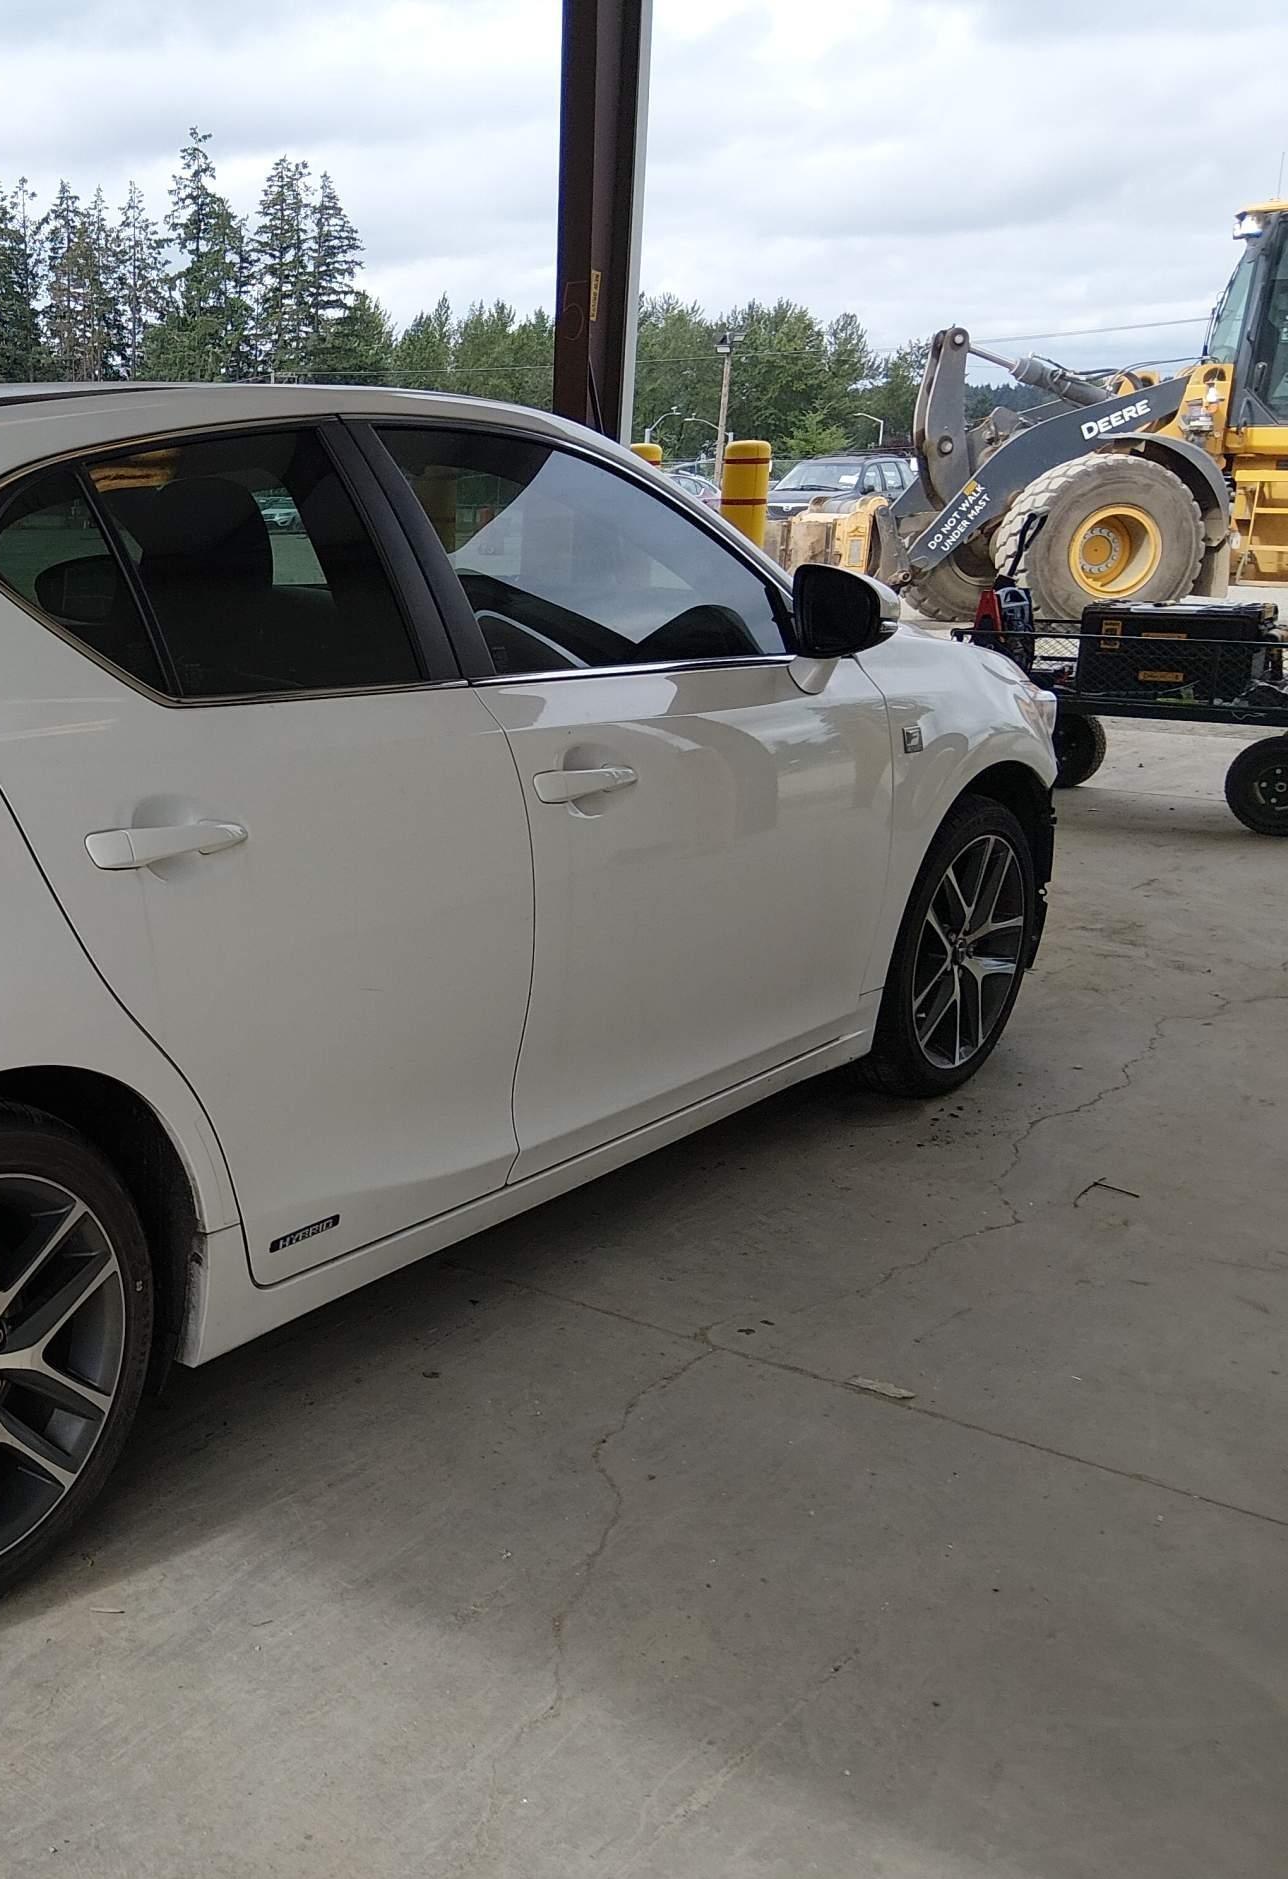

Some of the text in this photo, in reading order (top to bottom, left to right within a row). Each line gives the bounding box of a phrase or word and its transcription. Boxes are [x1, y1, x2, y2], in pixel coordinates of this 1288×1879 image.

[1080, 399, 1152, 440] DEERE
[927, 483, 986, 550] DO NOT WALK
[940, 493, 991, 551] UNDER MAST
[279, 1218, 334, 1249] HYBRID
